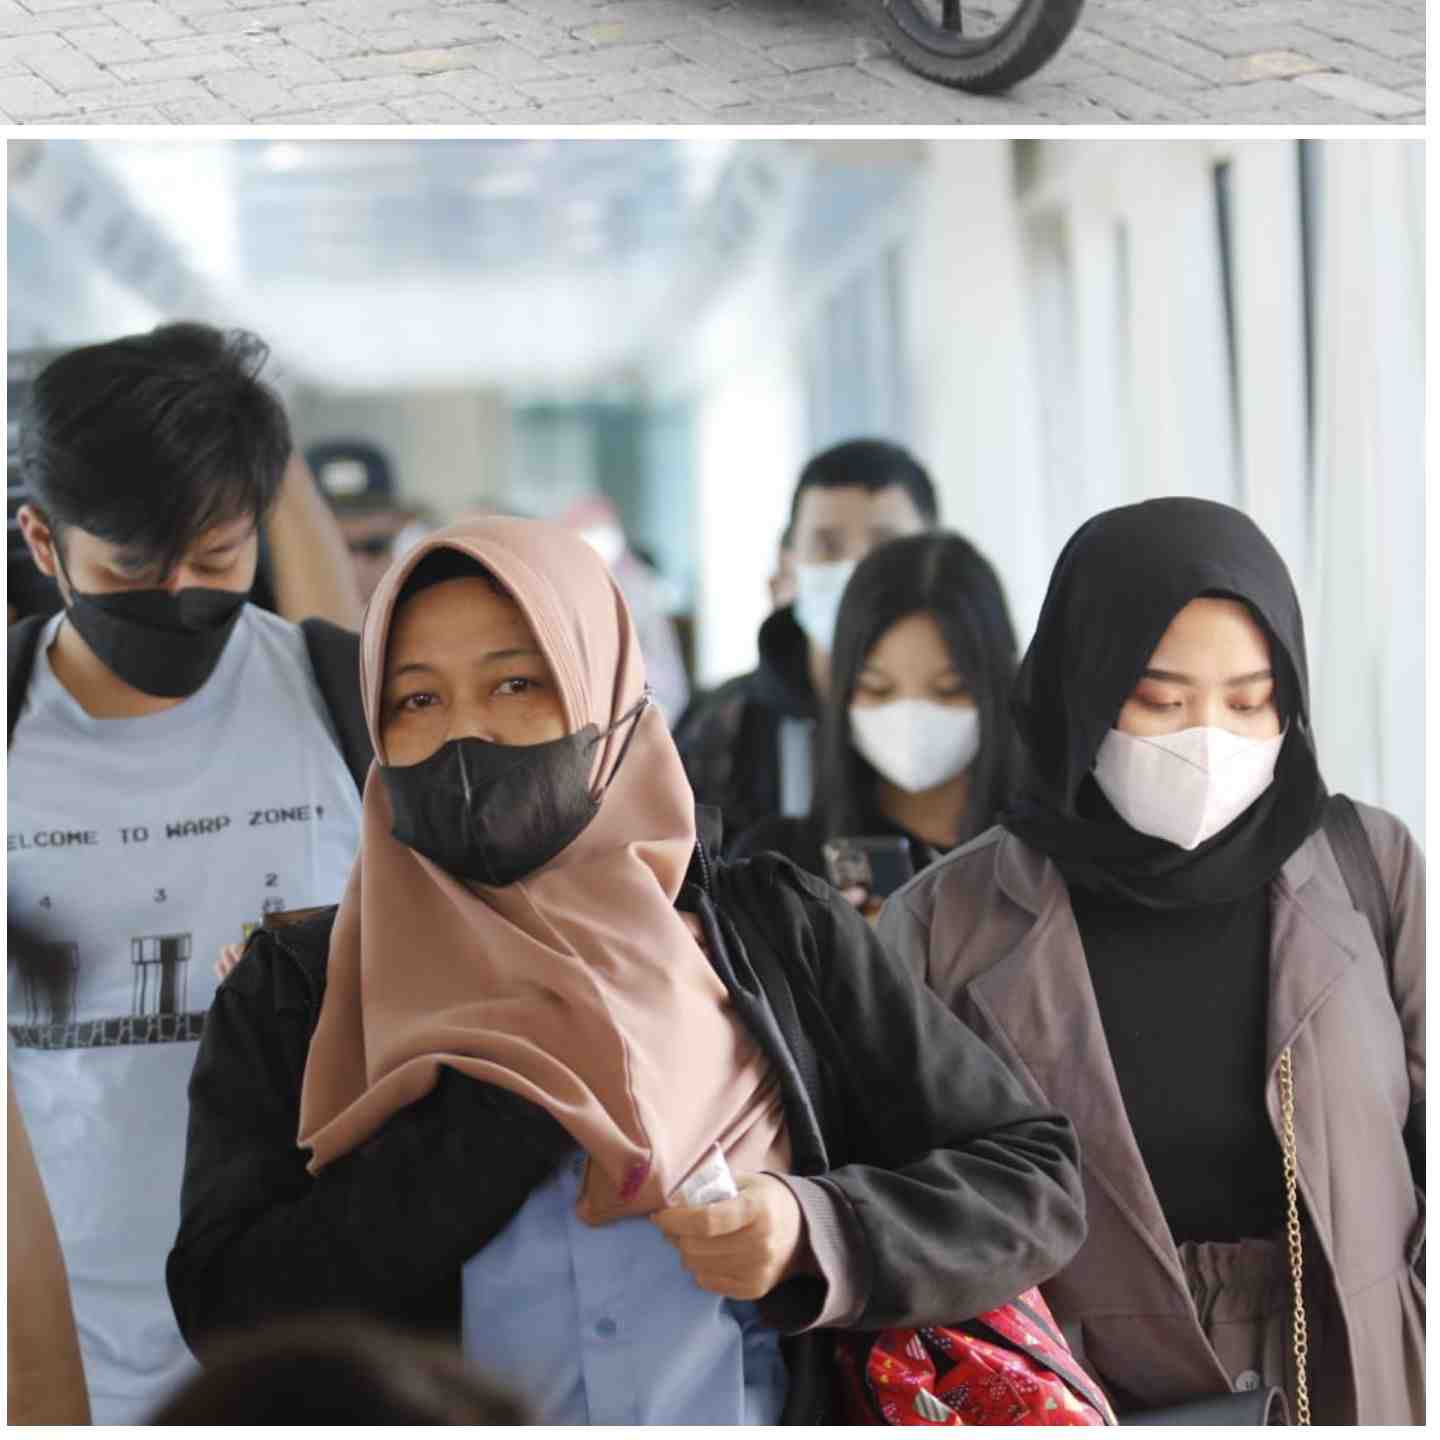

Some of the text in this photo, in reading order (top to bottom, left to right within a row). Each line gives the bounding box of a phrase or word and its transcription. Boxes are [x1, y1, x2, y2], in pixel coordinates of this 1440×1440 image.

[119, 826, 149, 845] TO
[165, 815, 232, 839] WARP
[264, 872, 280, 888] 2
[39, 887, 168, 911] 4 3
